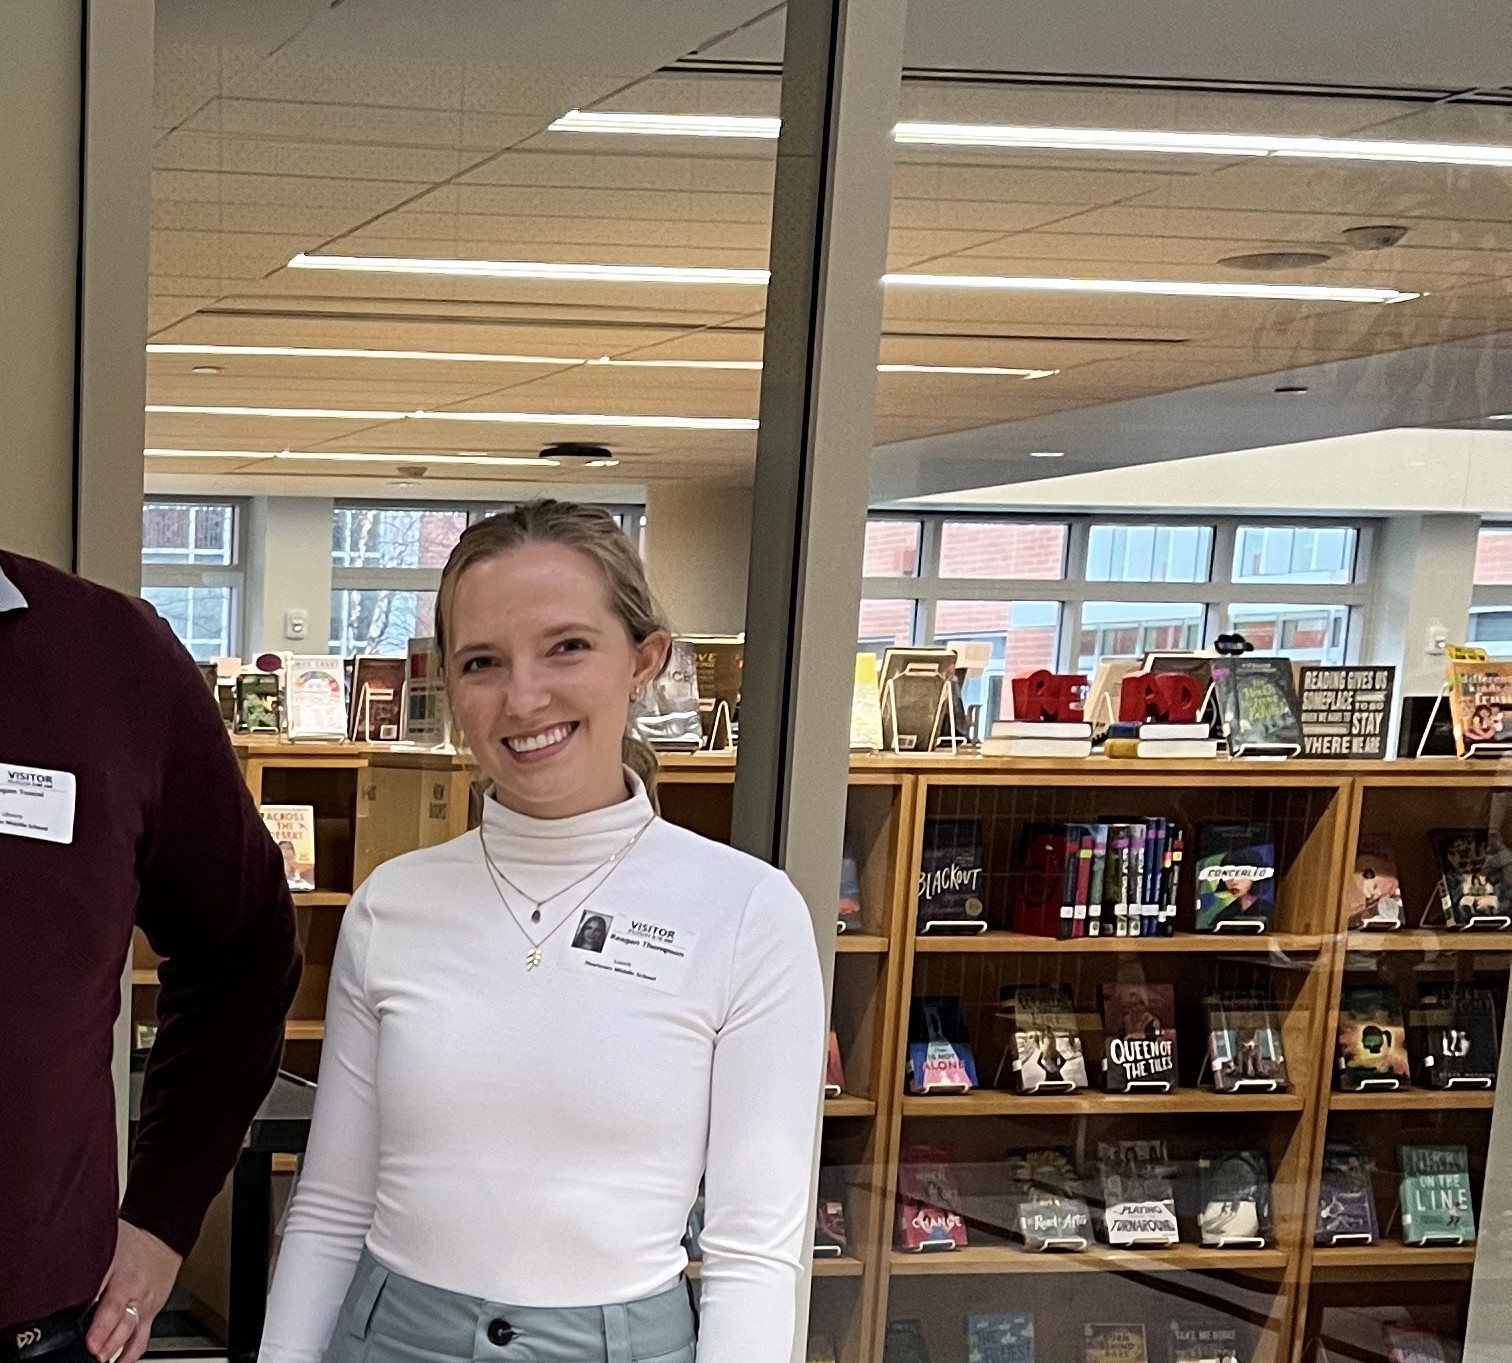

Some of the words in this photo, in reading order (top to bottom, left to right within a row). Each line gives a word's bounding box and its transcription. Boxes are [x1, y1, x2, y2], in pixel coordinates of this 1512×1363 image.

[1304, 671, 1346, 690] READING
[1374, 671, 1388, 690] US
[1302, 690, 1354, 710] SOMEPLACE
[1352, 712, 1384, 735] STAY
[8, 770, 53, 784] VISITOR
[266, 812, 304, 821] ACROSS
[277, 822, 294, 830] THE
[270, 831, 303, 840] ESERT
[918, 863, 982, 899] BLACKOUT
[631, 920, 676, 938] VISITOR
[1110, 1038, 1157, 1065] QUEEN
[1157, 1041, 1172, 1056] OF
[923, 1060, 965, 1070] ALONE
[1122, 1059, 1149, 1080] THE
[1149, 1056, 1174, 1074] TILES
[1415, 1188, 1468, 1211] LINE
[1110, 1219, 1176, 1232] TURNAROUND
